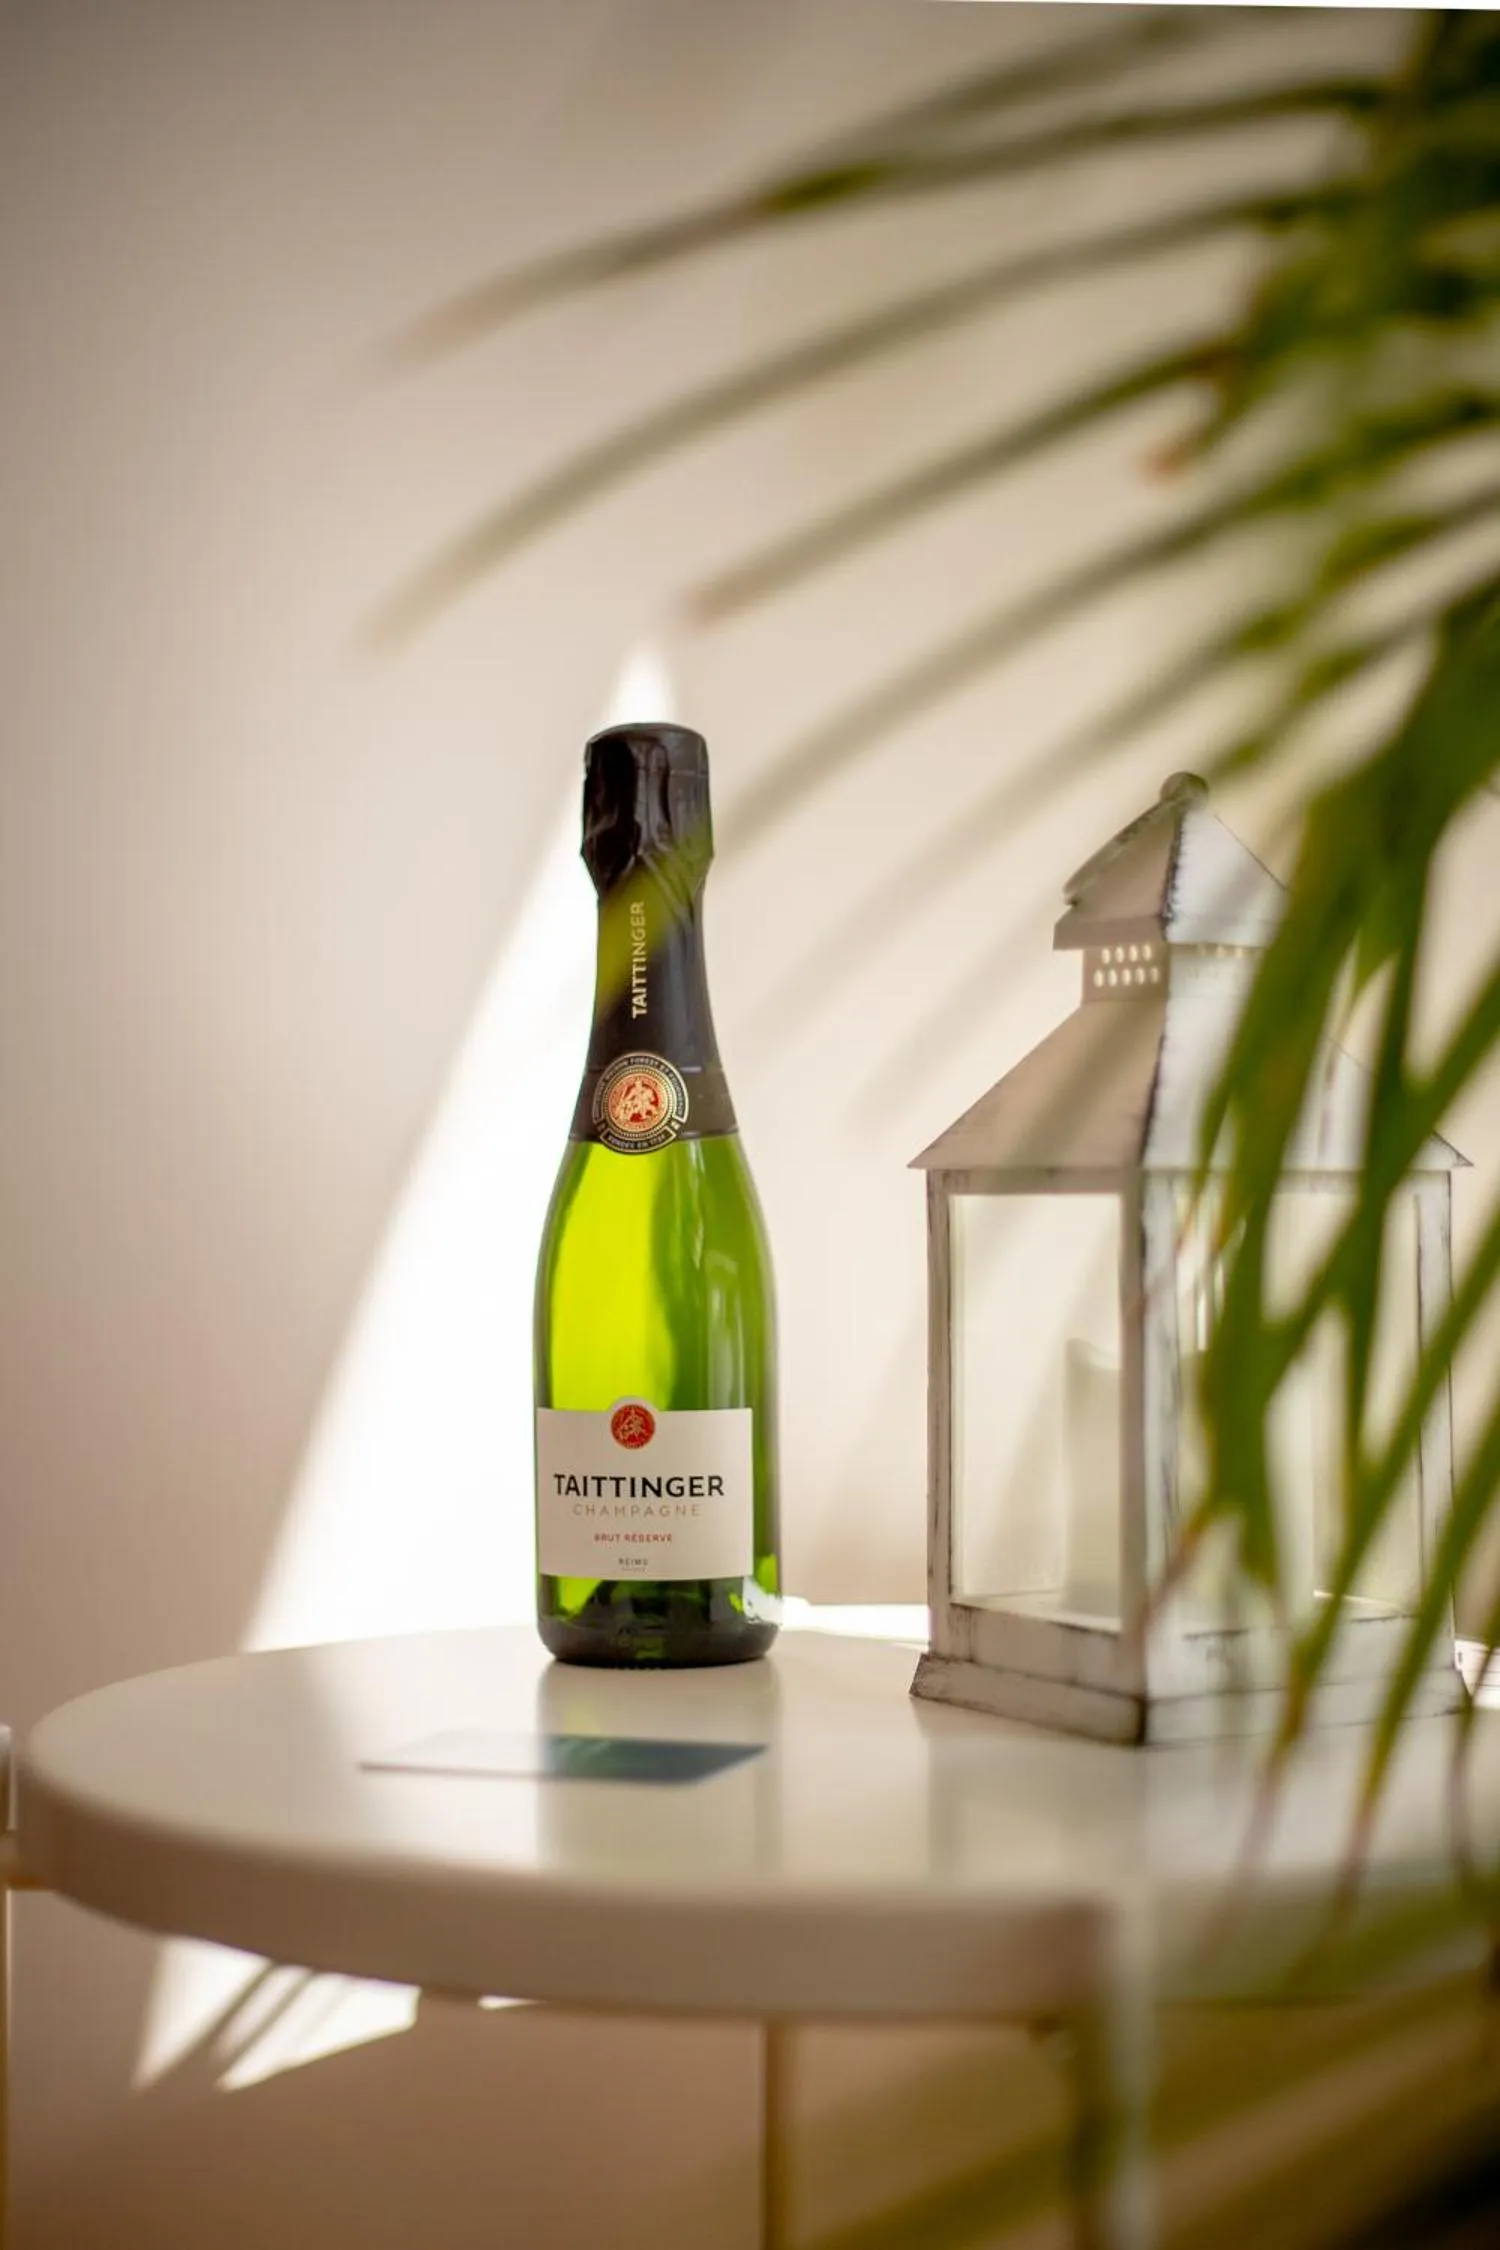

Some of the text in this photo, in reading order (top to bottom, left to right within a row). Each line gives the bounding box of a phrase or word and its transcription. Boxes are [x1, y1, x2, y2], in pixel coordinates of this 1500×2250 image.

[630, 901, 648, 1019] TAITTINGER
[554, 1473, 725, 1498] TAITTINGER
[572, 1503, 701, 1518] CHAMPAGNE
[594, 1533, 621, 1543] BRUT
[618, 1558, 649, 1566] REIMS
